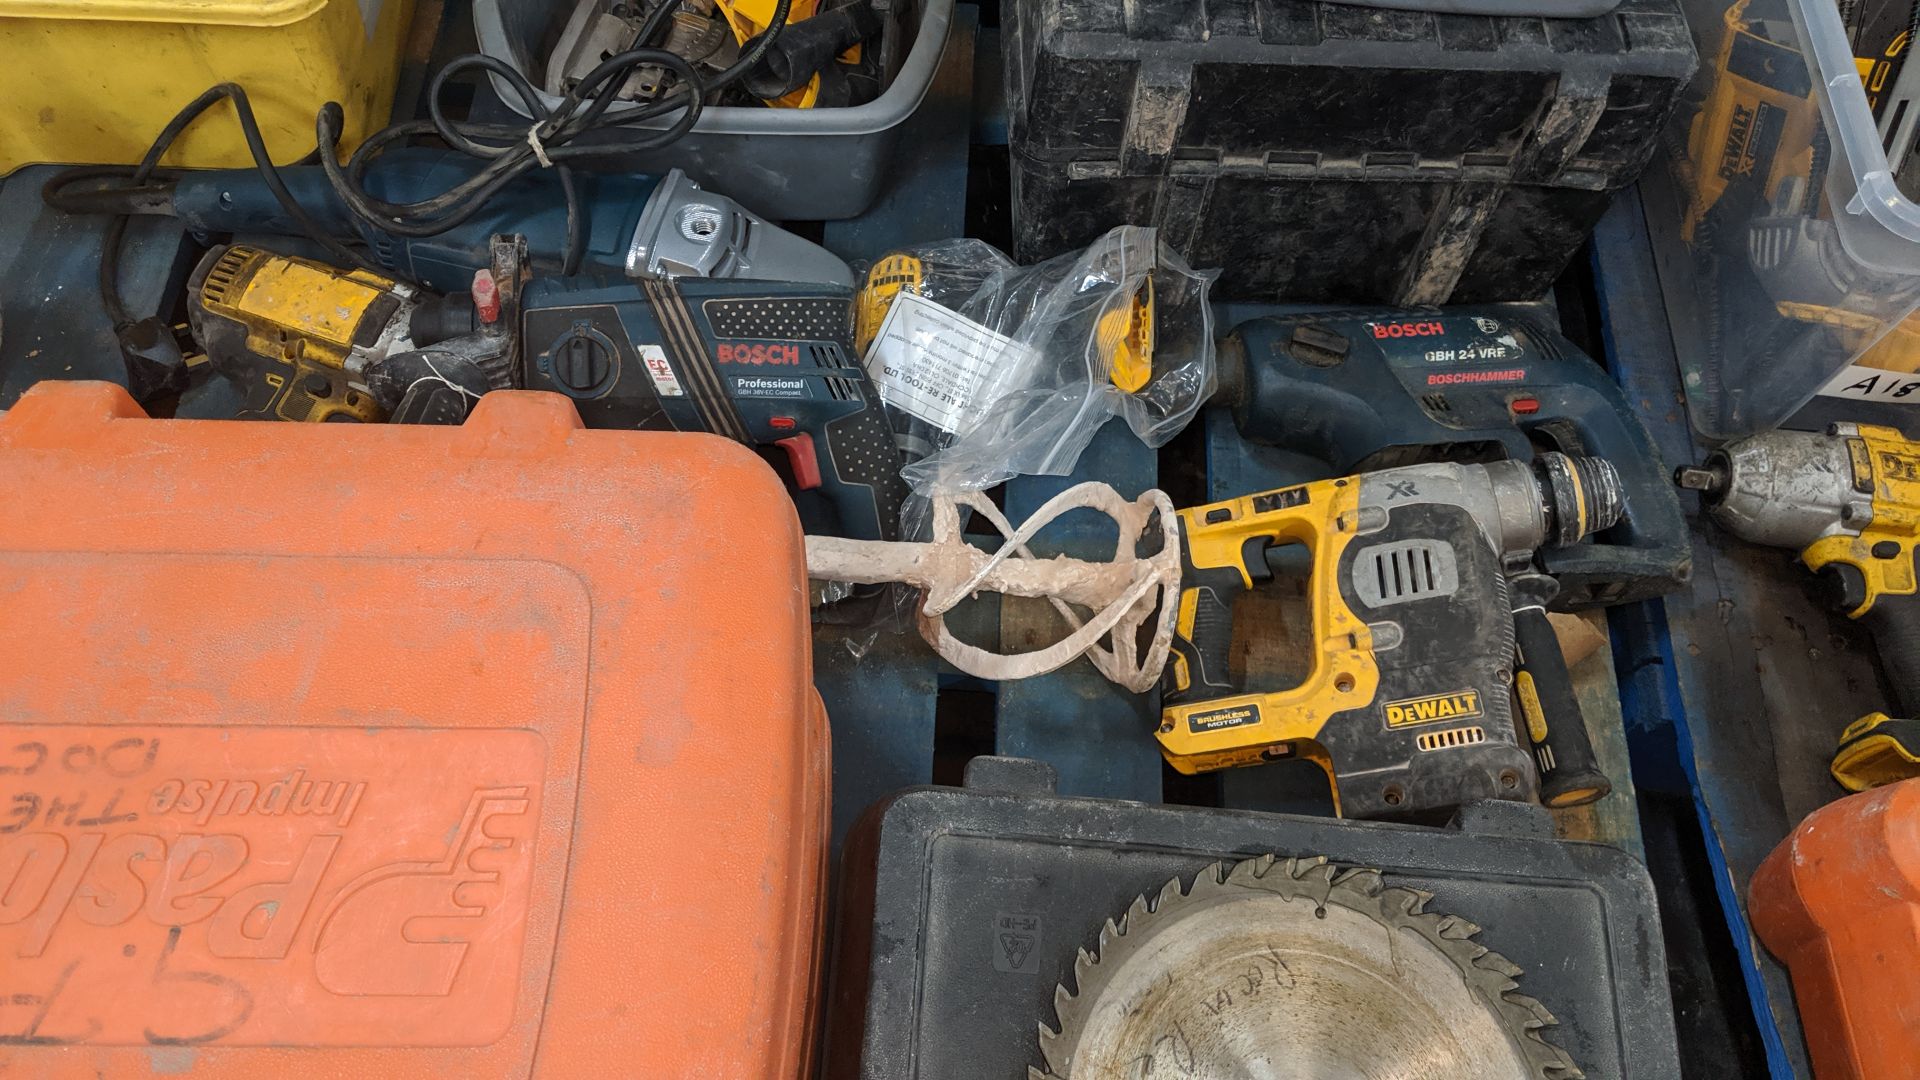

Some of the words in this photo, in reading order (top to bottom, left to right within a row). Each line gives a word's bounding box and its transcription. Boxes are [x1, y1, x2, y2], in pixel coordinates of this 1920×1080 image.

[1374, 322, 1444, 338] BOSCH
[717, 343, 799, 365] BOSCH
[1425, 351, 1454, 361] GBH
[1459, 349, 1475, 360] 24
[738, 379, 803, 388] Professional
[1428, 370, 1525, 384] BOSCHHAMMER
[900, 374, 939, 397] RE-TOOL
[1841, 374, 1920, 398] A18
[1385, 481, 1421, 500] XR
[1196, 710, 1251, 725] BRUSHLESS
[1207, 717, 1243, 729] MOTOR
[149, 768, 369, 829] Impulse
